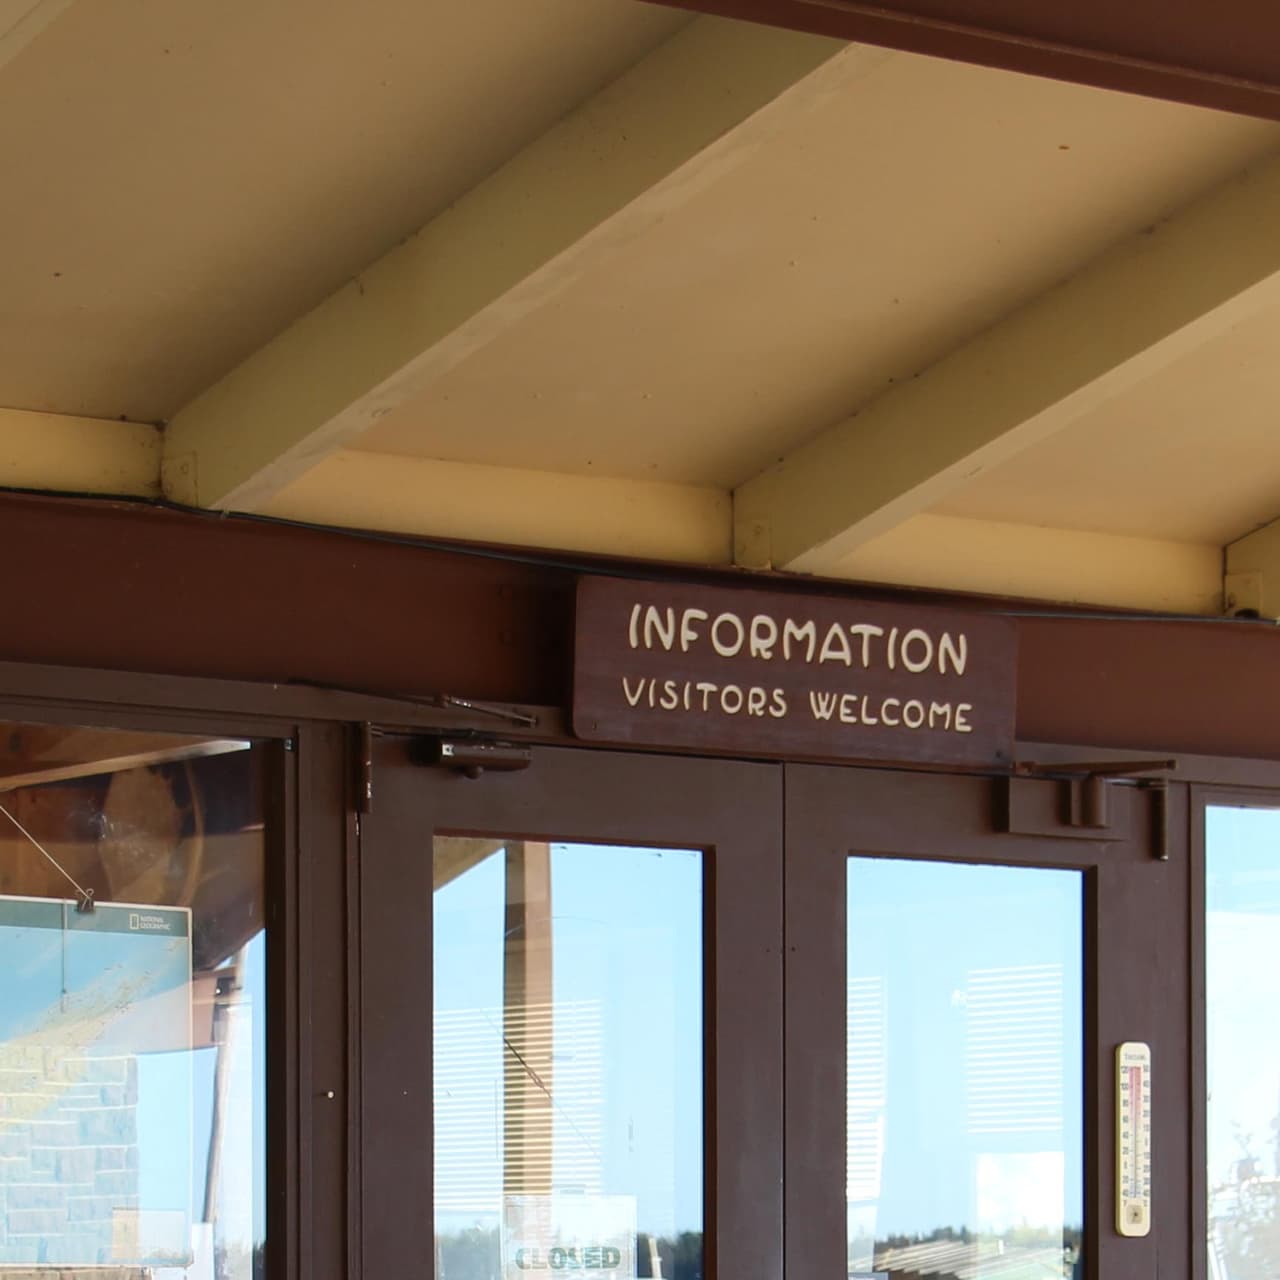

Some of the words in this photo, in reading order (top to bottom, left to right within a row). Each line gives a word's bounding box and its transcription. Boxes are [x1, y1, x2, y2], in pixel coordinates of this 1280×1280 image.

[628, 603, 967, 676] INFORMATION
[621, 677, 788, 718] VISITORS
[809, 690, 973, 732] WELCOME
[515, 1247, 621, 1270] CLOSED
